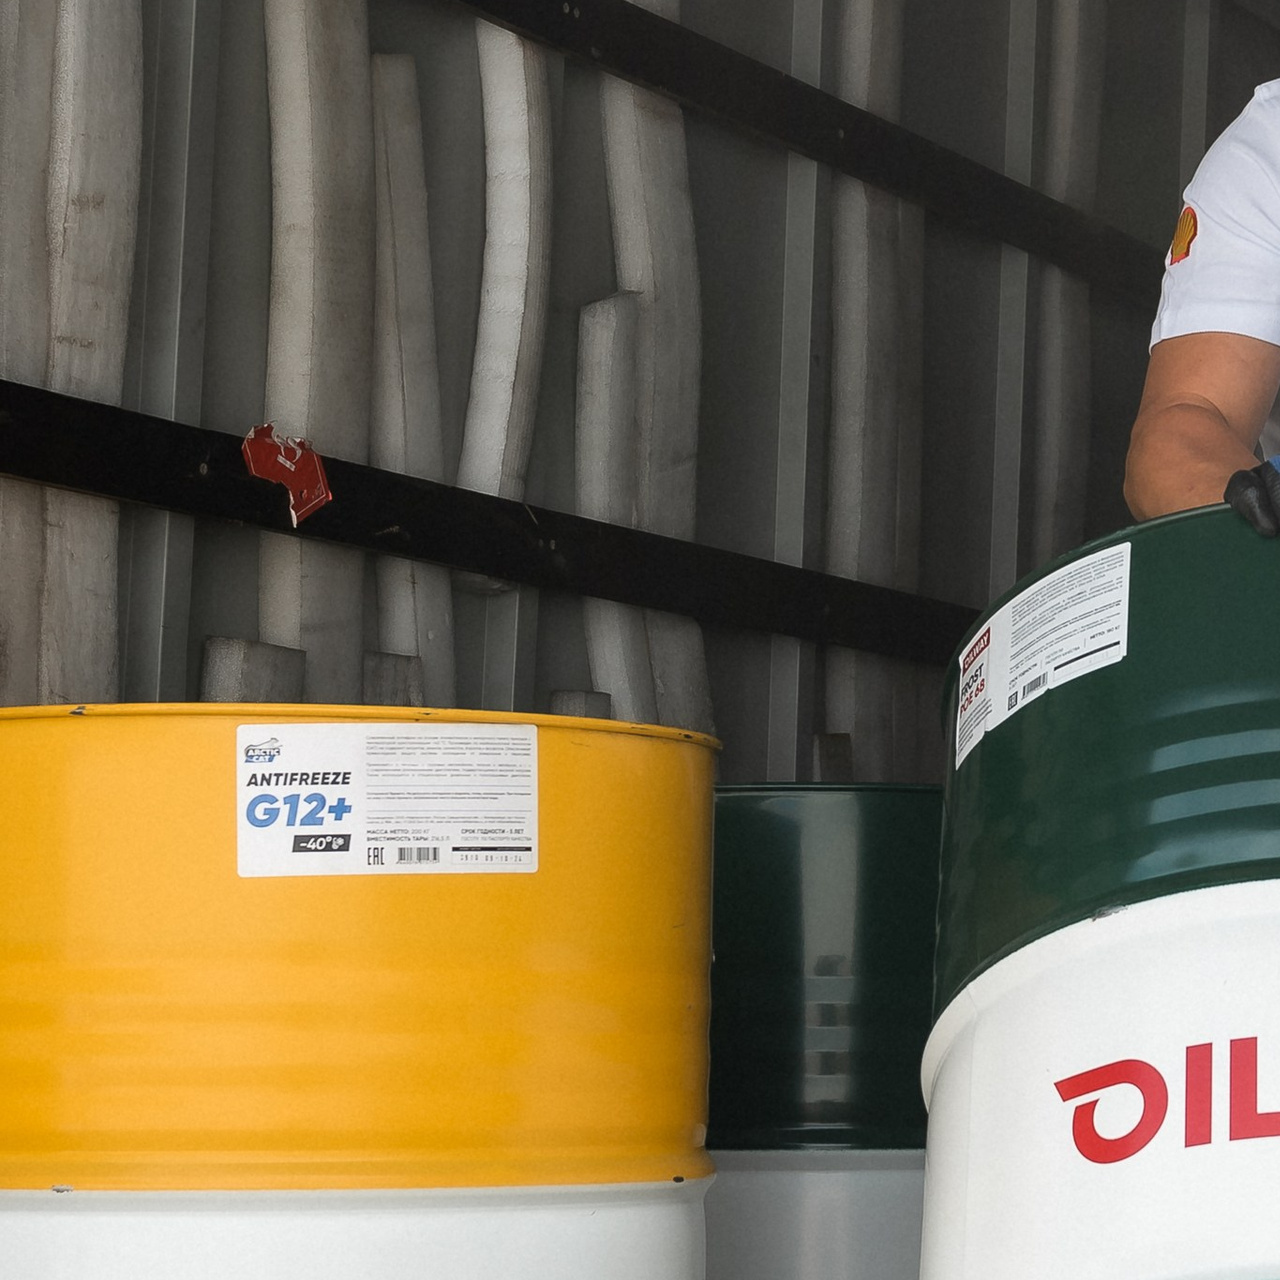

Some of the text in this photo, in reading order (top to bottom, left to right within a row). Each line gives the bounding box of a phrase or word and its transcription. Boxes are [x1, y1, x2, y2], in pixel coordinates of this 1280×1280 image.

[961, 663, 984, 702] FROST
[247, 748, 280, 756] ARCTIC
[246, 772, 352, 787] ANTIFREEZE
[246, 792, 352, 828] G12+
